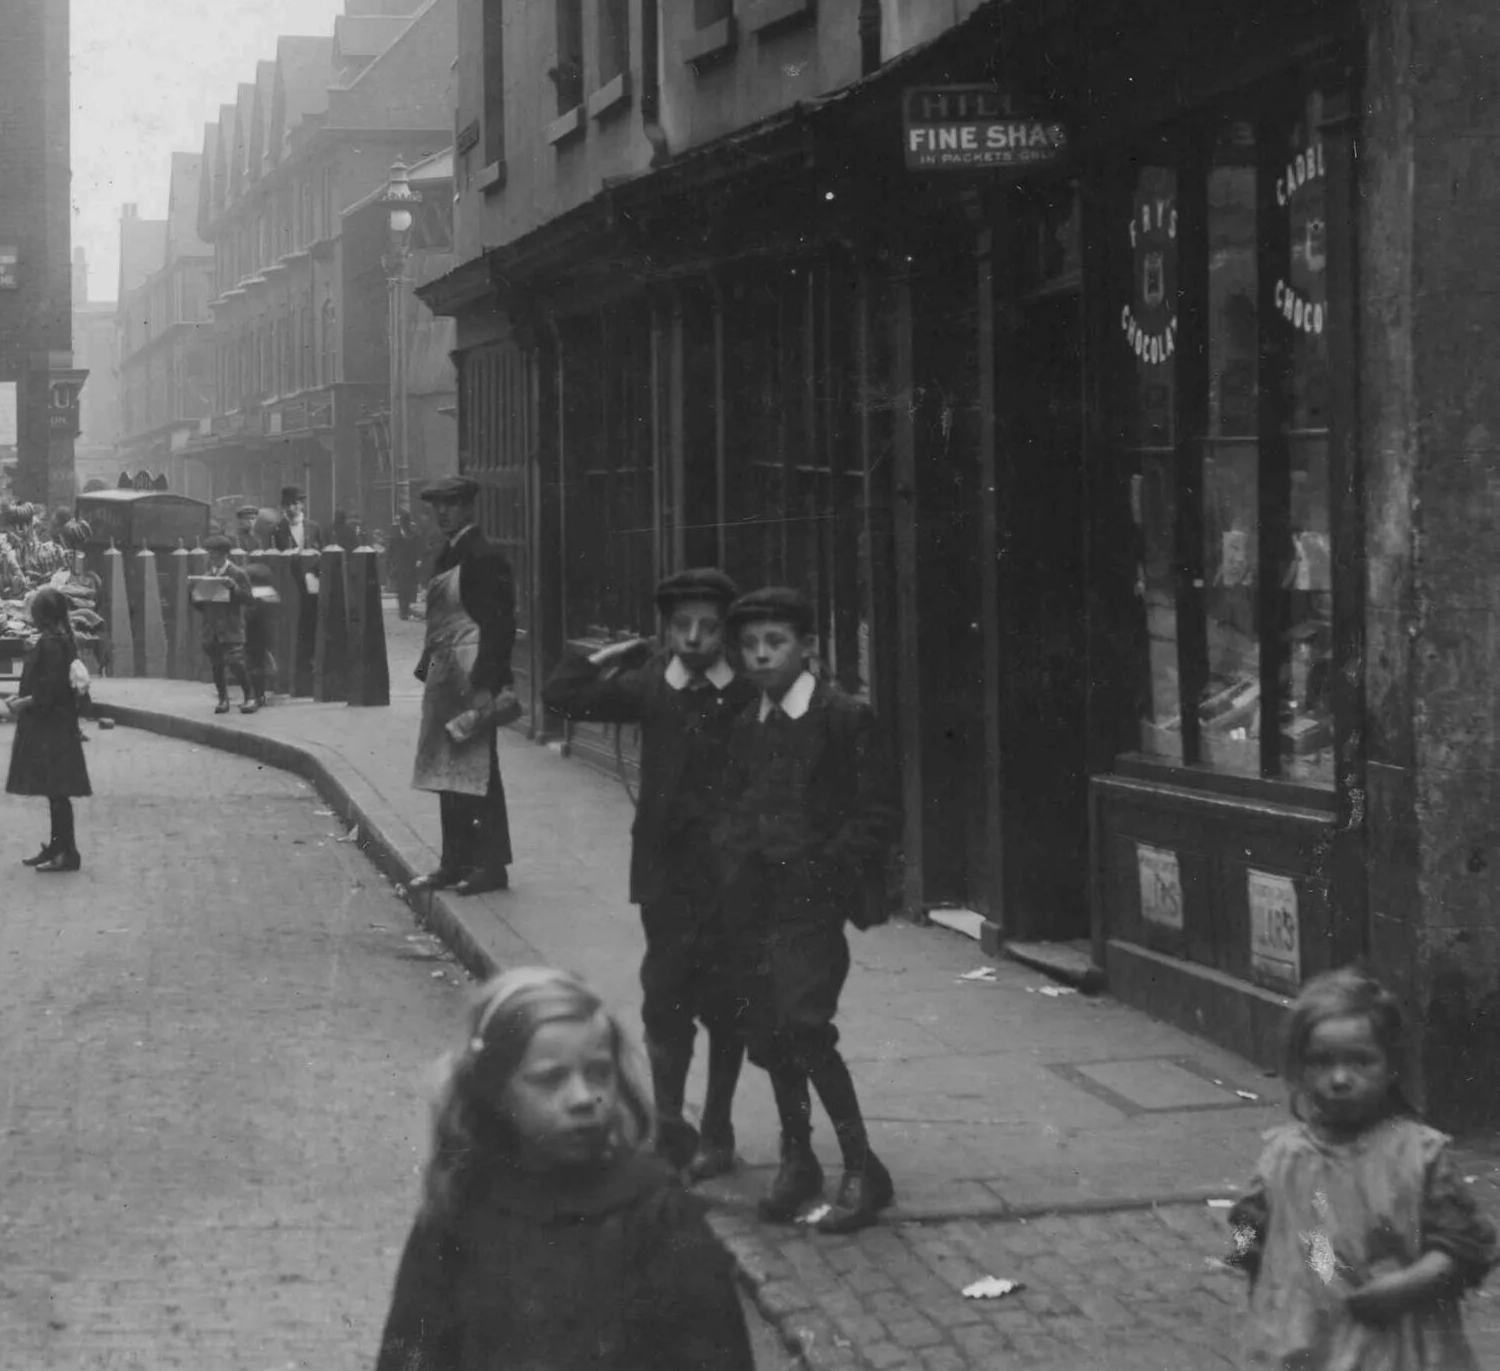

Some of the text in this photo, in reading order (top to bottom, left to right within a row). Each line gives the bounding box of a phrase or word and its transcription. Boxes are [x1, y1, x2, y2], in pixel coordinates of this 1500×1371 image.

[909, 123, 1067, 152] FINE SHAG
[920, 155, 936, 164] IN
[942, 151, 1012, 164] PACKETS
